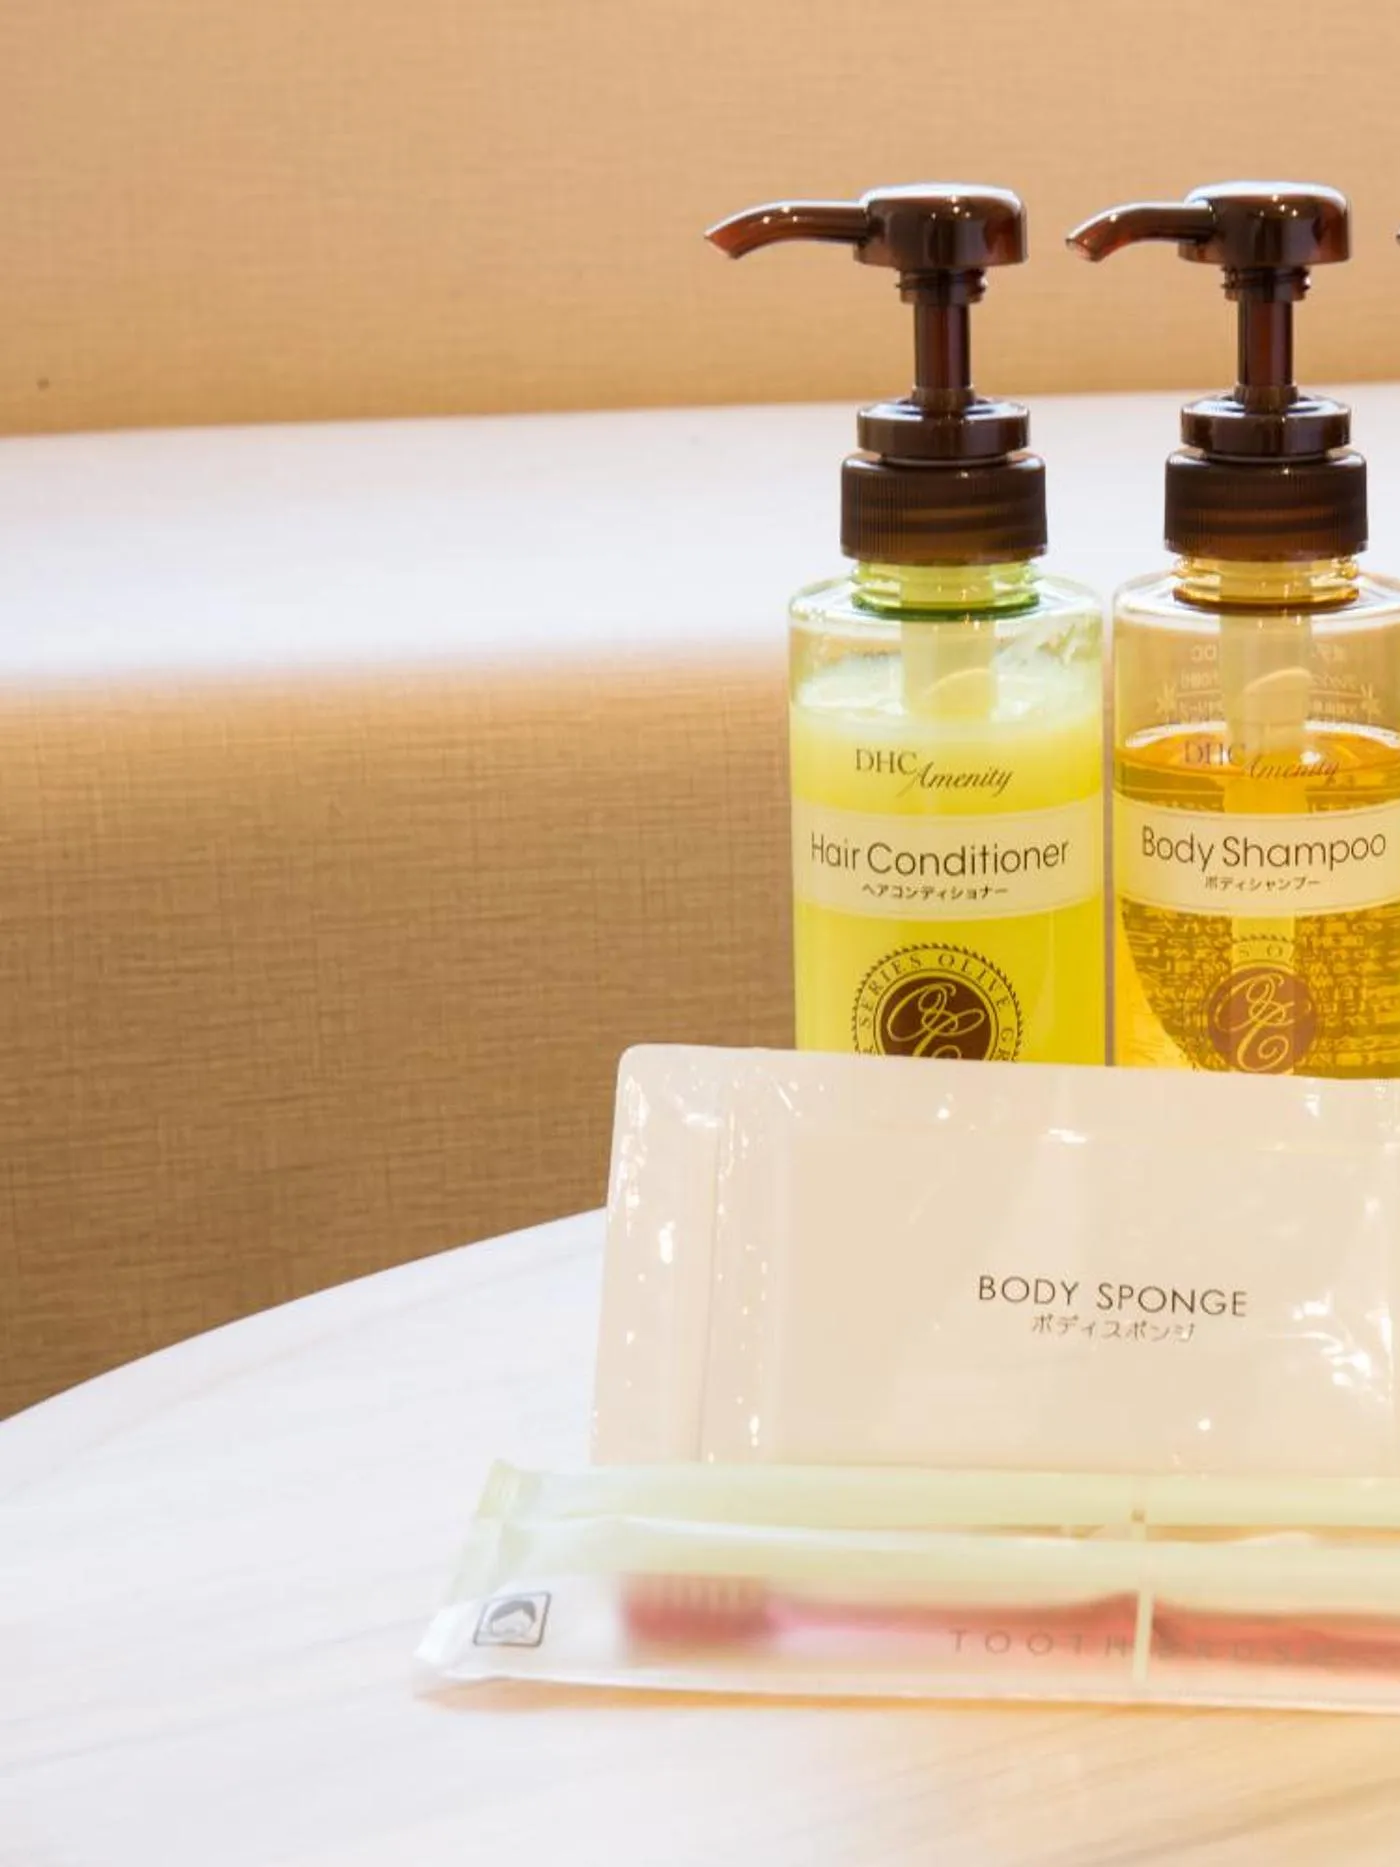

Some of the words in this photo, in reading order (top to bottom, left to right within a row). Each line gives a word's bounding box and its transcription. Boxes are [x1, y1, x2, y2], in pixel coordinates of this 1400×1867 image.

[856, 748, 918, 775] DHC
[897, 761, 1013, 798] Amenity
[1184, 740, 1247, 766] DHC
[810, 832, 860, 870] Hair
[867, 838, 1070, 877] Conditioner
[1142, 825, 1215, 872] Body
[1223, 833, 1387, 872] Shampoo
[979, 1274, 1080, 1306] BODY
[1096, 1282, 1248, 1317] SPONGE
[1031, 1314, 1196, 1342] ボディスポンジ
